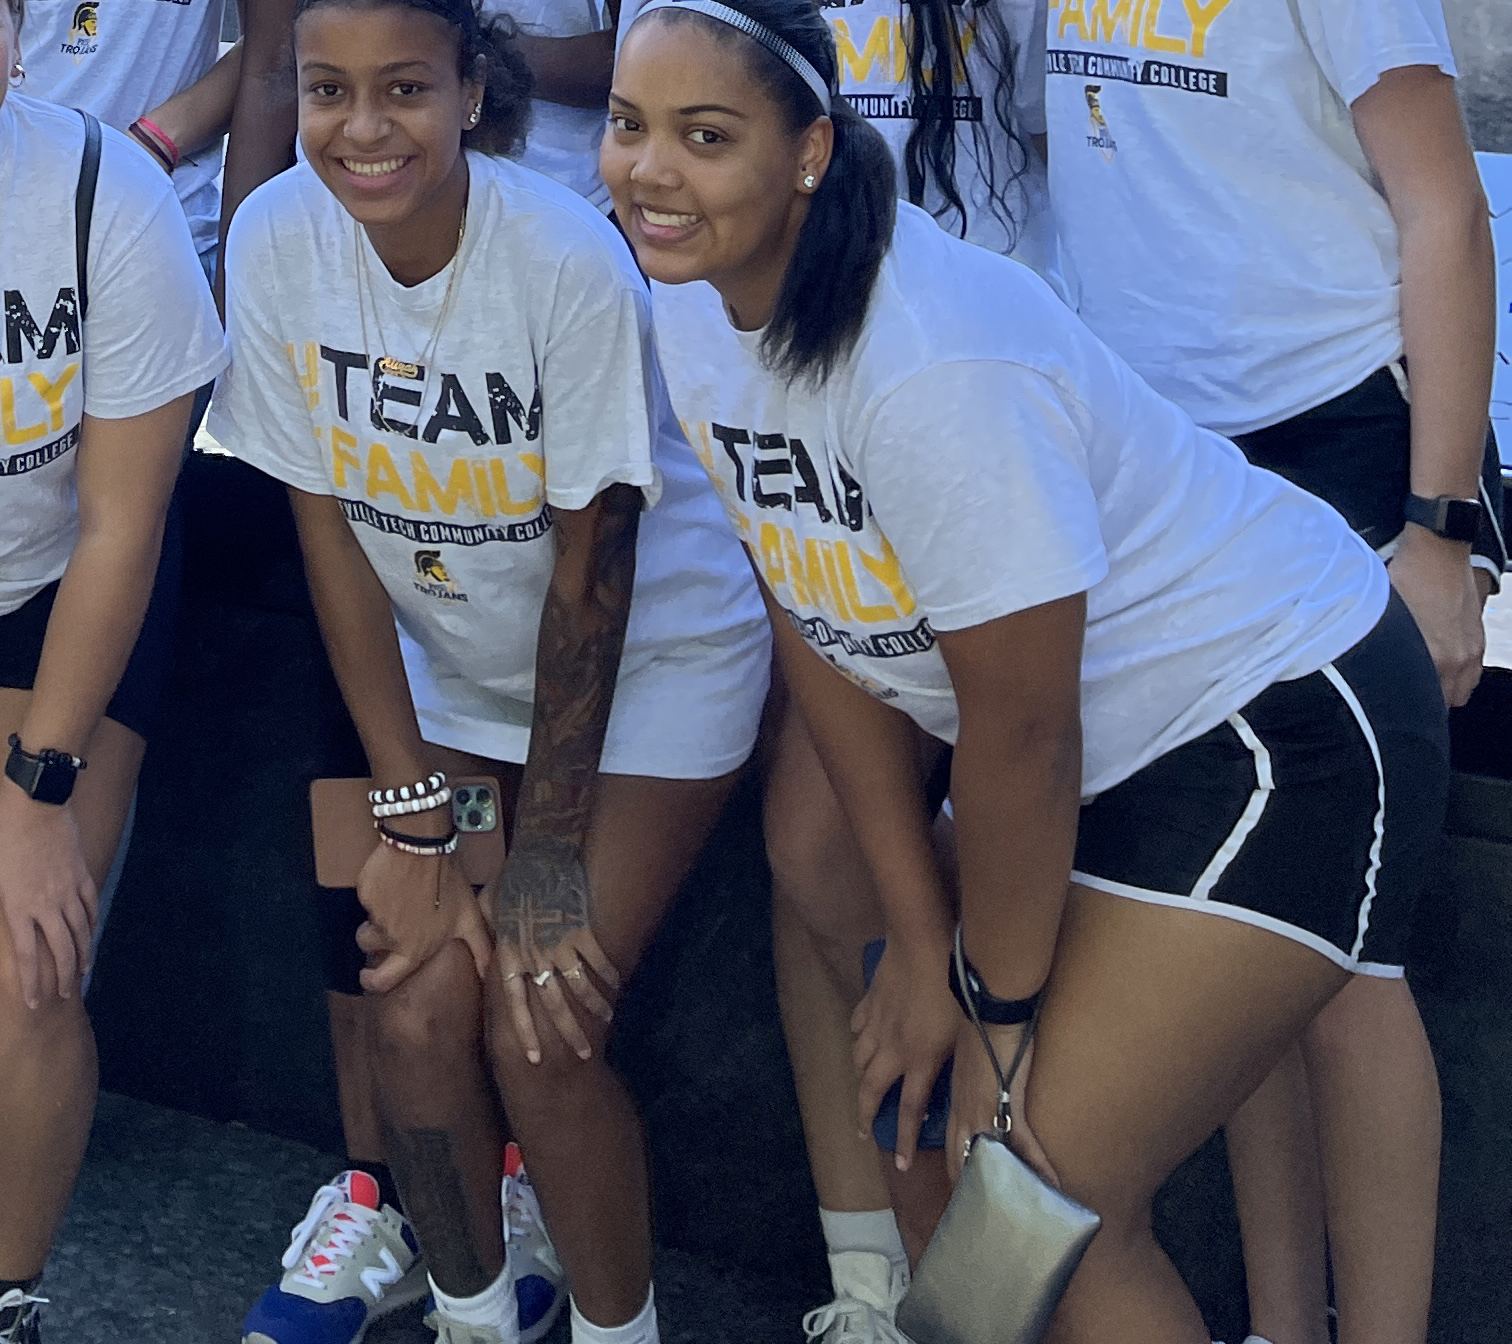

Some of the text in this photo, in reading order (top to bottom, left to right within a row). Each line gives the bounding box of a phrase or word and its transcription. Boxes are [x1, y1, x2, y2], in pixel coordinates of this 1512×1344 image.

[1149, 64, 1218, 94] COLLEGE
[320, 344, 543, 447] TEAM
[15, 432, 76, 473] COLLEGE
[381, 513, 416, 540] TECH
[419, 523, 510, 548] COMMUNITY
[744, 512, 917, 625] AMILY
